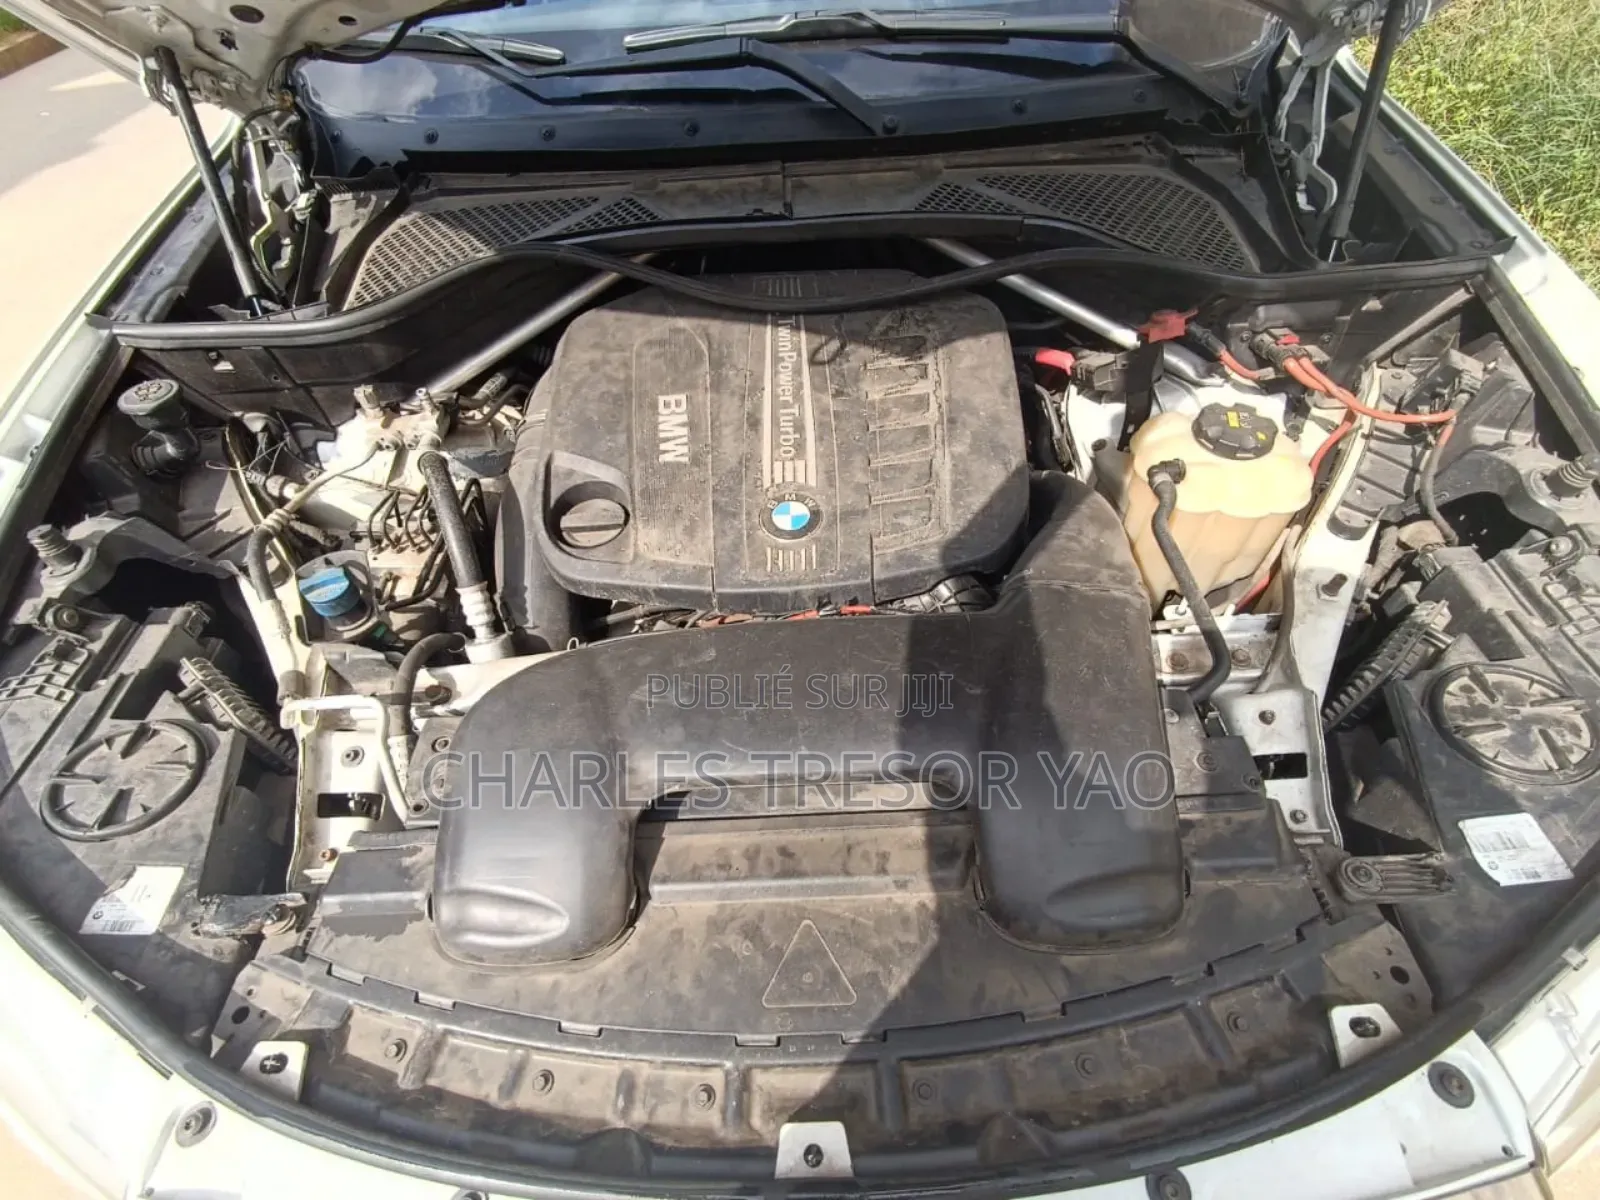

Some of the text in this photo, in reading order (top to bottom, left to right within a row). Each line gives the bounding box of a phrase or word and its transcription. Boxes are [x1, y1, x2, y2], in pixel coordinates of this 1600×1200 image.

[777, 315, 800, 459] TwinPower Turbo
[657, 394, 690, 464] BMW
[767, 492, 816, 509] BMW
